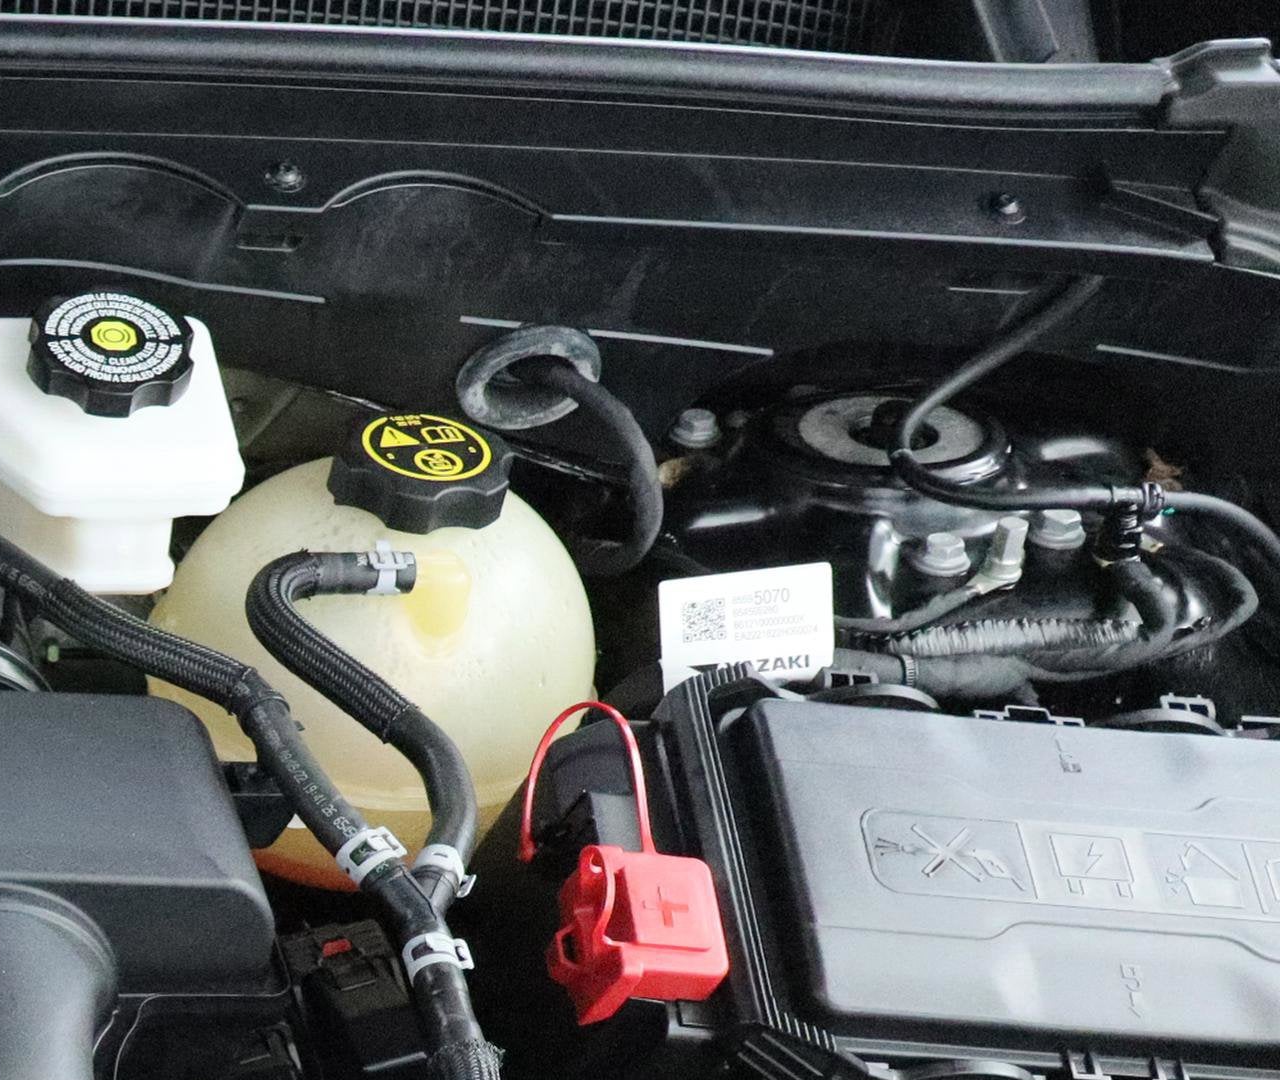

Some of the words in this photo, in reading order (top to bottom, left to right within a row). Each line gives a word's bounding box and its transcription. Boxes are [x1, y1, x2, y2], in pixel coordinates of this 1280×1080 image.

[59, 339, 76, 353] CAP
[107, 356, 140, 365] CLEAN
[135, 341, 156, 361] FILLER
[59, 356, 86, 373] FLUID
[82, 368, 111, 382] FROM
[112, 374, 120, 382] A
[119, 369, 156, 382] SEALED
[67, 350, 101, 371] BEFORE
